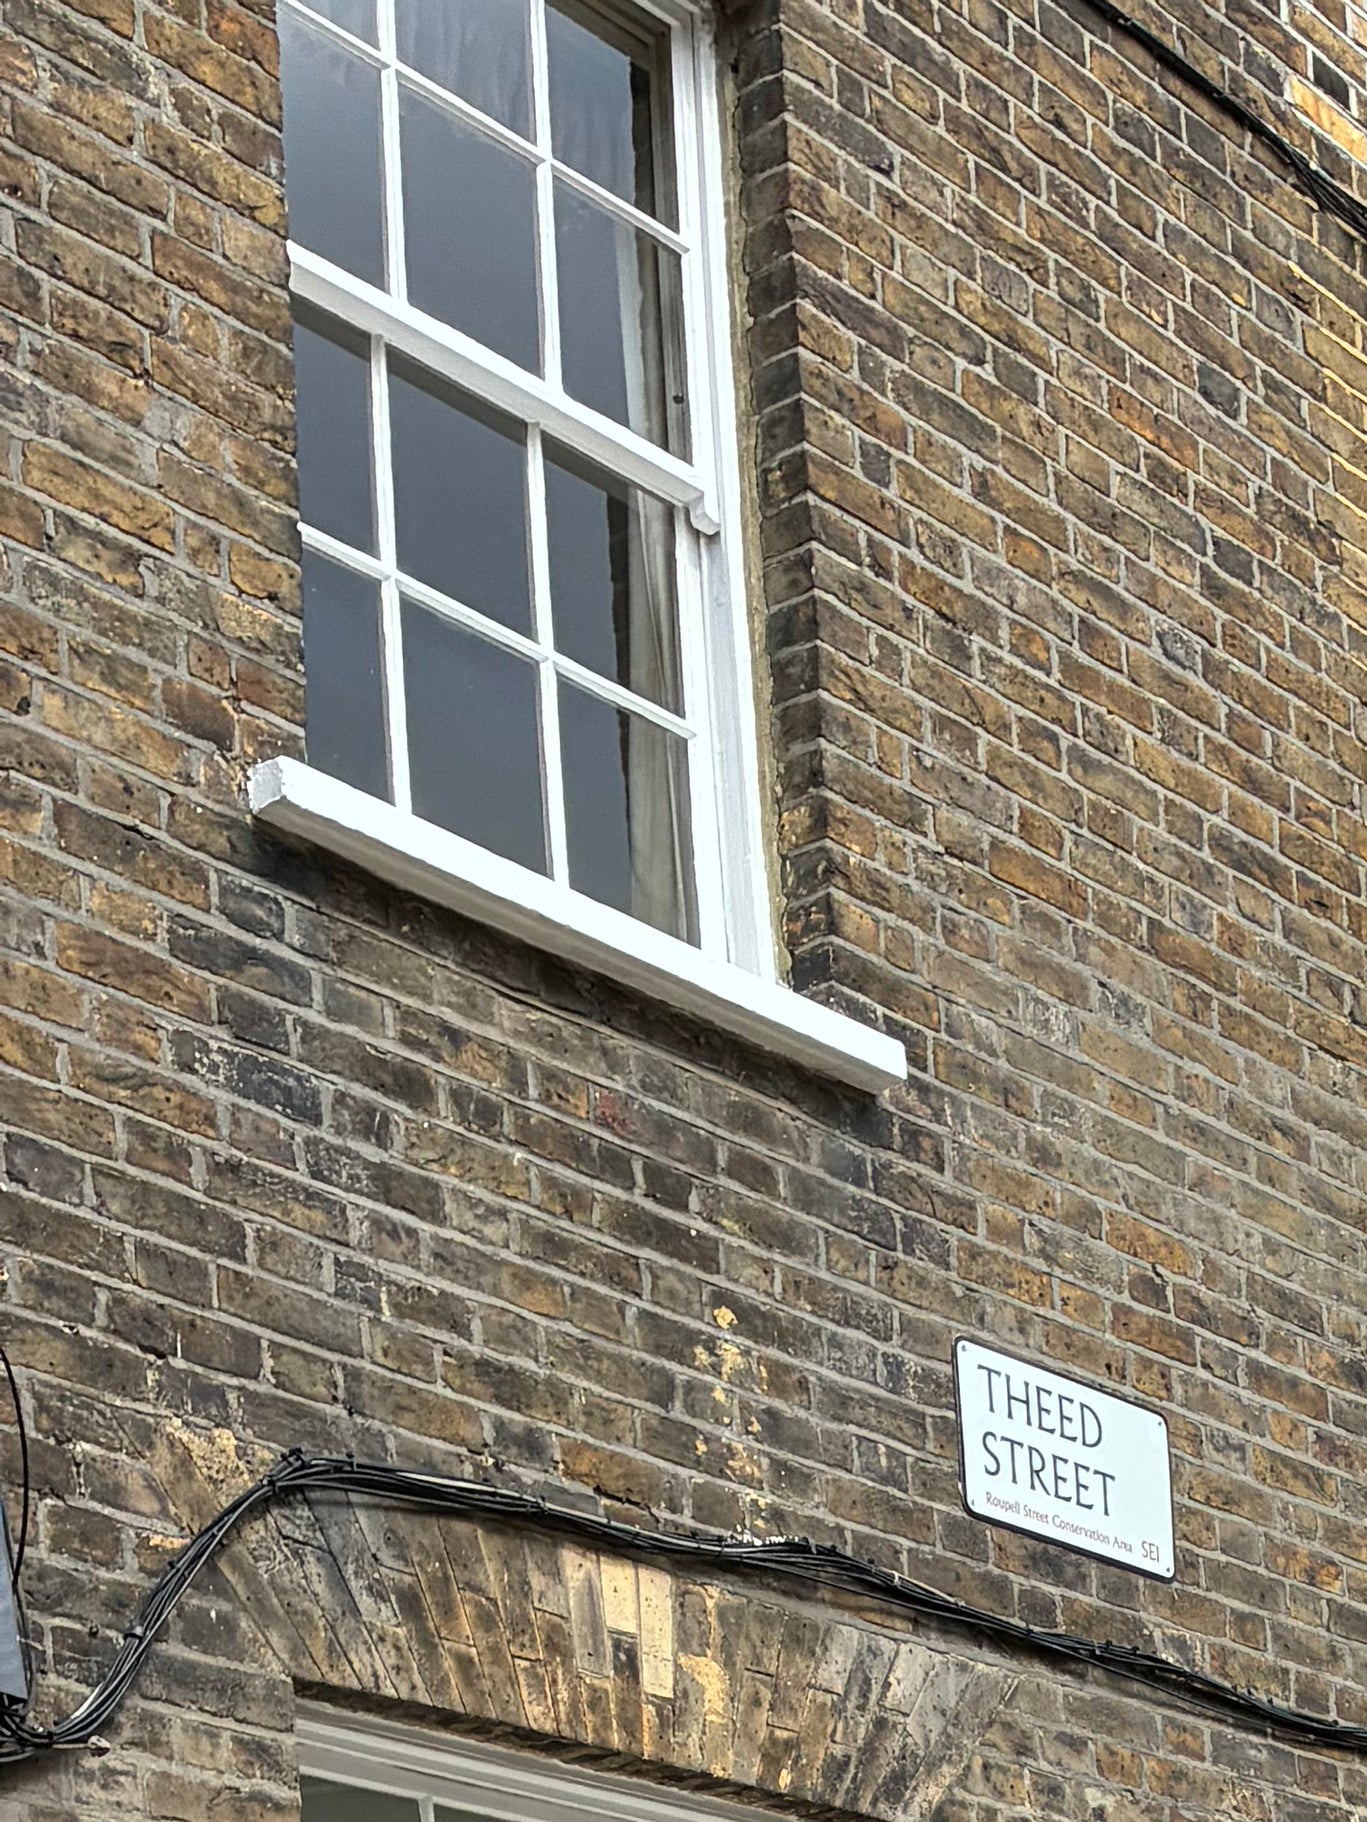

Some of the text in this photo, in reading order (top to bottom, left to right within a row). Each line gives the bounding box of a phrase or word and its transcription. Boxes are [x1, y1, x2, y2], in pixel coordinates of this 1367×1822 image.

[977, 1363, 1103, 1449] THEED
[981, 1431, 1116, 1517] STREET
[985, 1491, 1021, 1515] Roupell
[1023, 1504, 1049, 1525] Street
[1052, 1514, 1111, 1545] Conservation
[1112, 1536, 1133, 1553] Area
